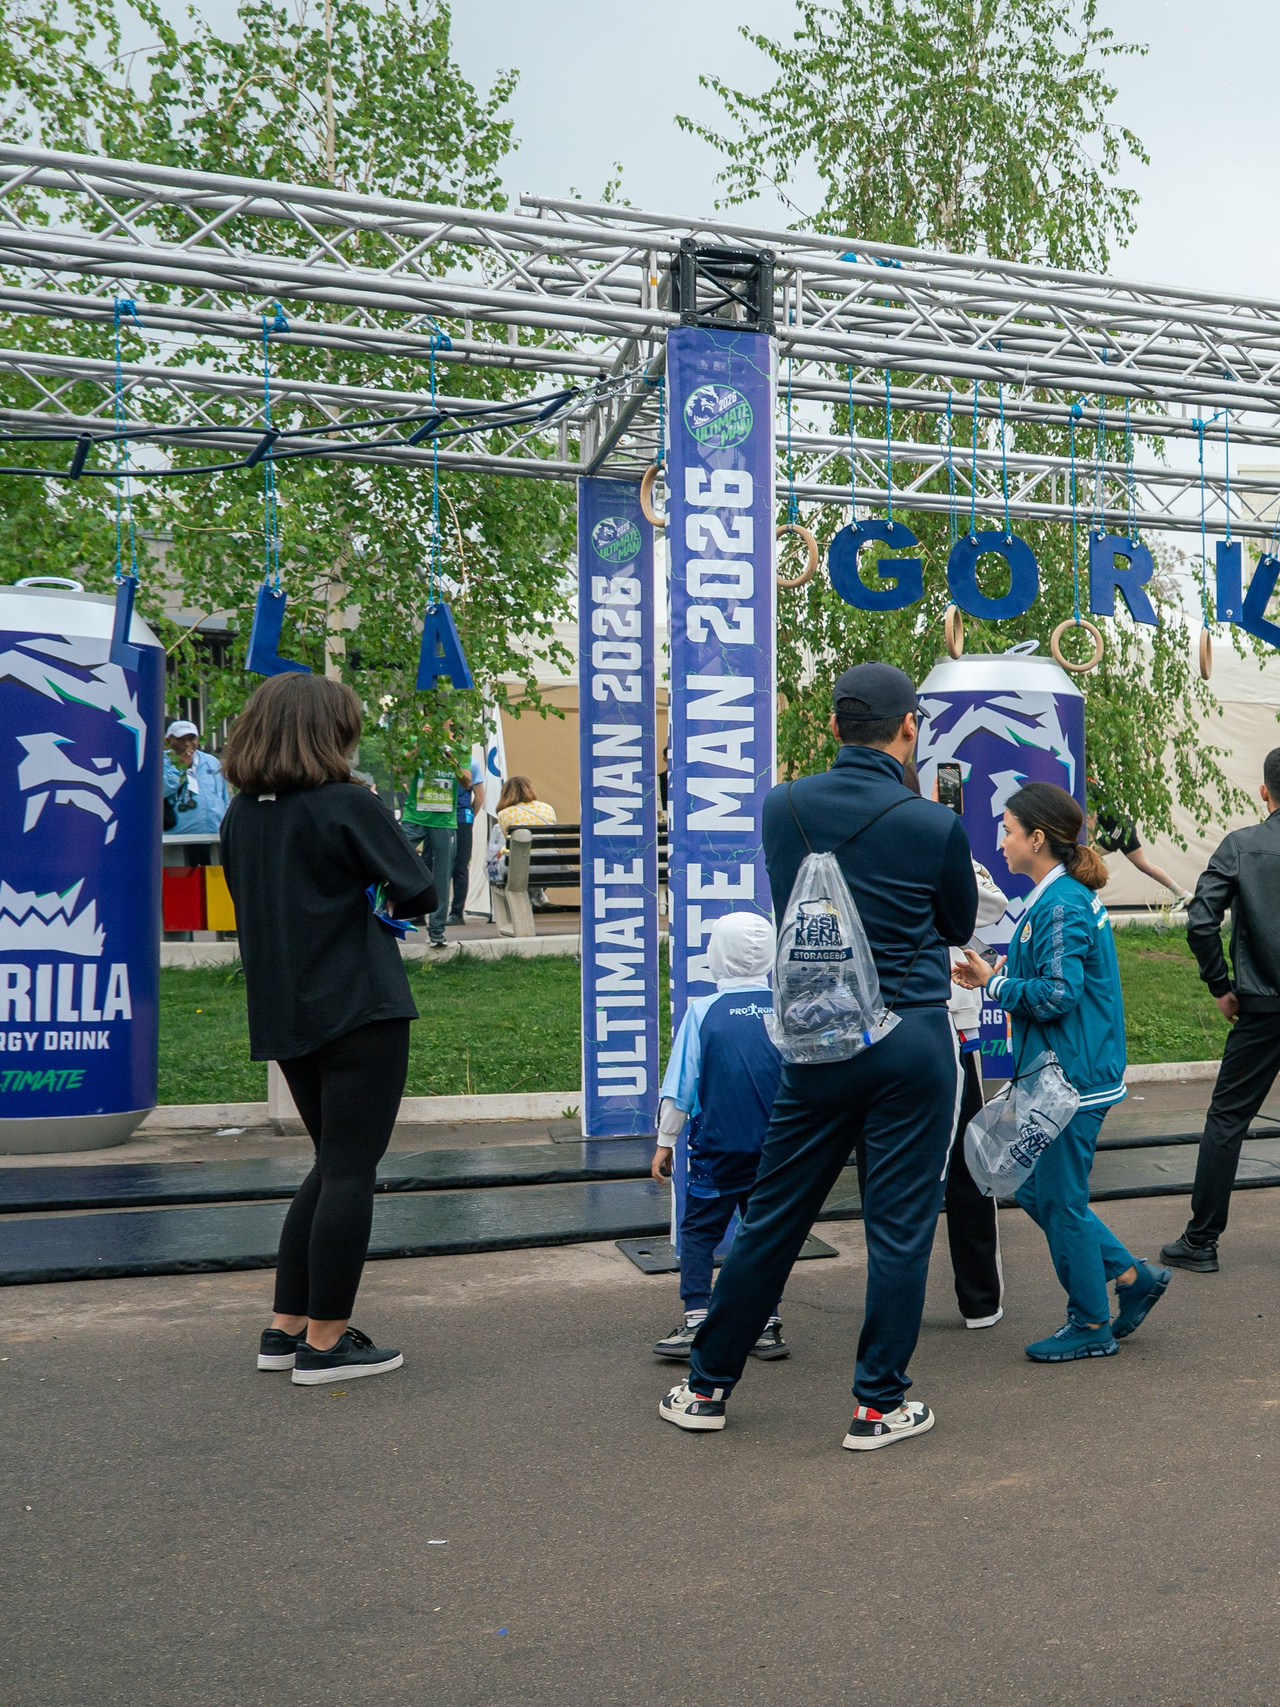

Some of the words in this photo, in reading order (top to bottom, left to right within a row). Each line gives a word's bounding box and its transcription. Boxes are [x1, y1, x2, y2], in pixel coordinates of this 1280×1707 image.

[718, 390, 738, 412] 2026
[695, 402, 751, 442] ULTIMATE
[720, 418, 751, 446] MAN
[600, 530, 640, 557] ULTIMATE
[617, 541, 640, 560] MAN
[685, 467, 755, 645] 2026
[591, 575, 642, 702] 2026
[686, 674, 755, 831] MAN
[592, 724, 643, 836] MAN
[593, 858, 647, 1097] ULTIMATE
[730, 1007, 748, 1016] PRO
[44, 1030, 111, 1051] DRINK
[0, 1069, 87, 1092] TIMATE
